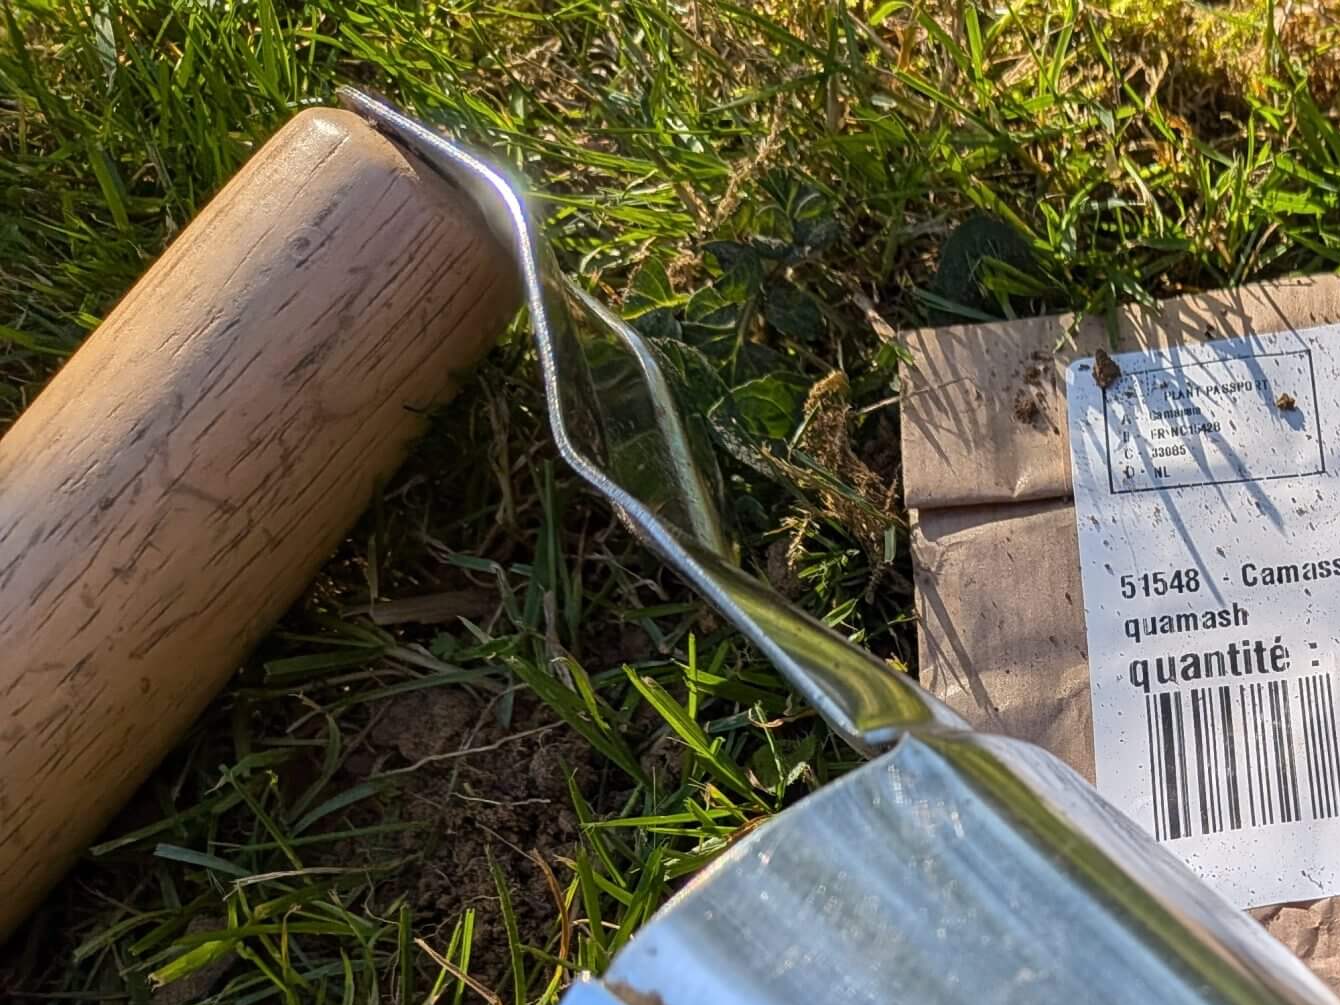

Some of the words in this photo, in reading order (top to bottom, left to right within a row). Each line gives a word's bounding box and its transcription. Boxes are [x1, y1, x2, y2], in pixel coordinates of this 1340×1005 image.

[1163, 385, 1200, 401] PLANT
[1205, 379, 1268, 397] PASSPORT
[1124, 448, 1133, 459] C
[1152, 444, 1187, 458] 33085
[1153, 466, 1170, 478] NL
[1120, 568, 1200, 600] 51548
[1124, 602, 1249, 644] quamash
[1129, 635, 1290, 693] quantité
